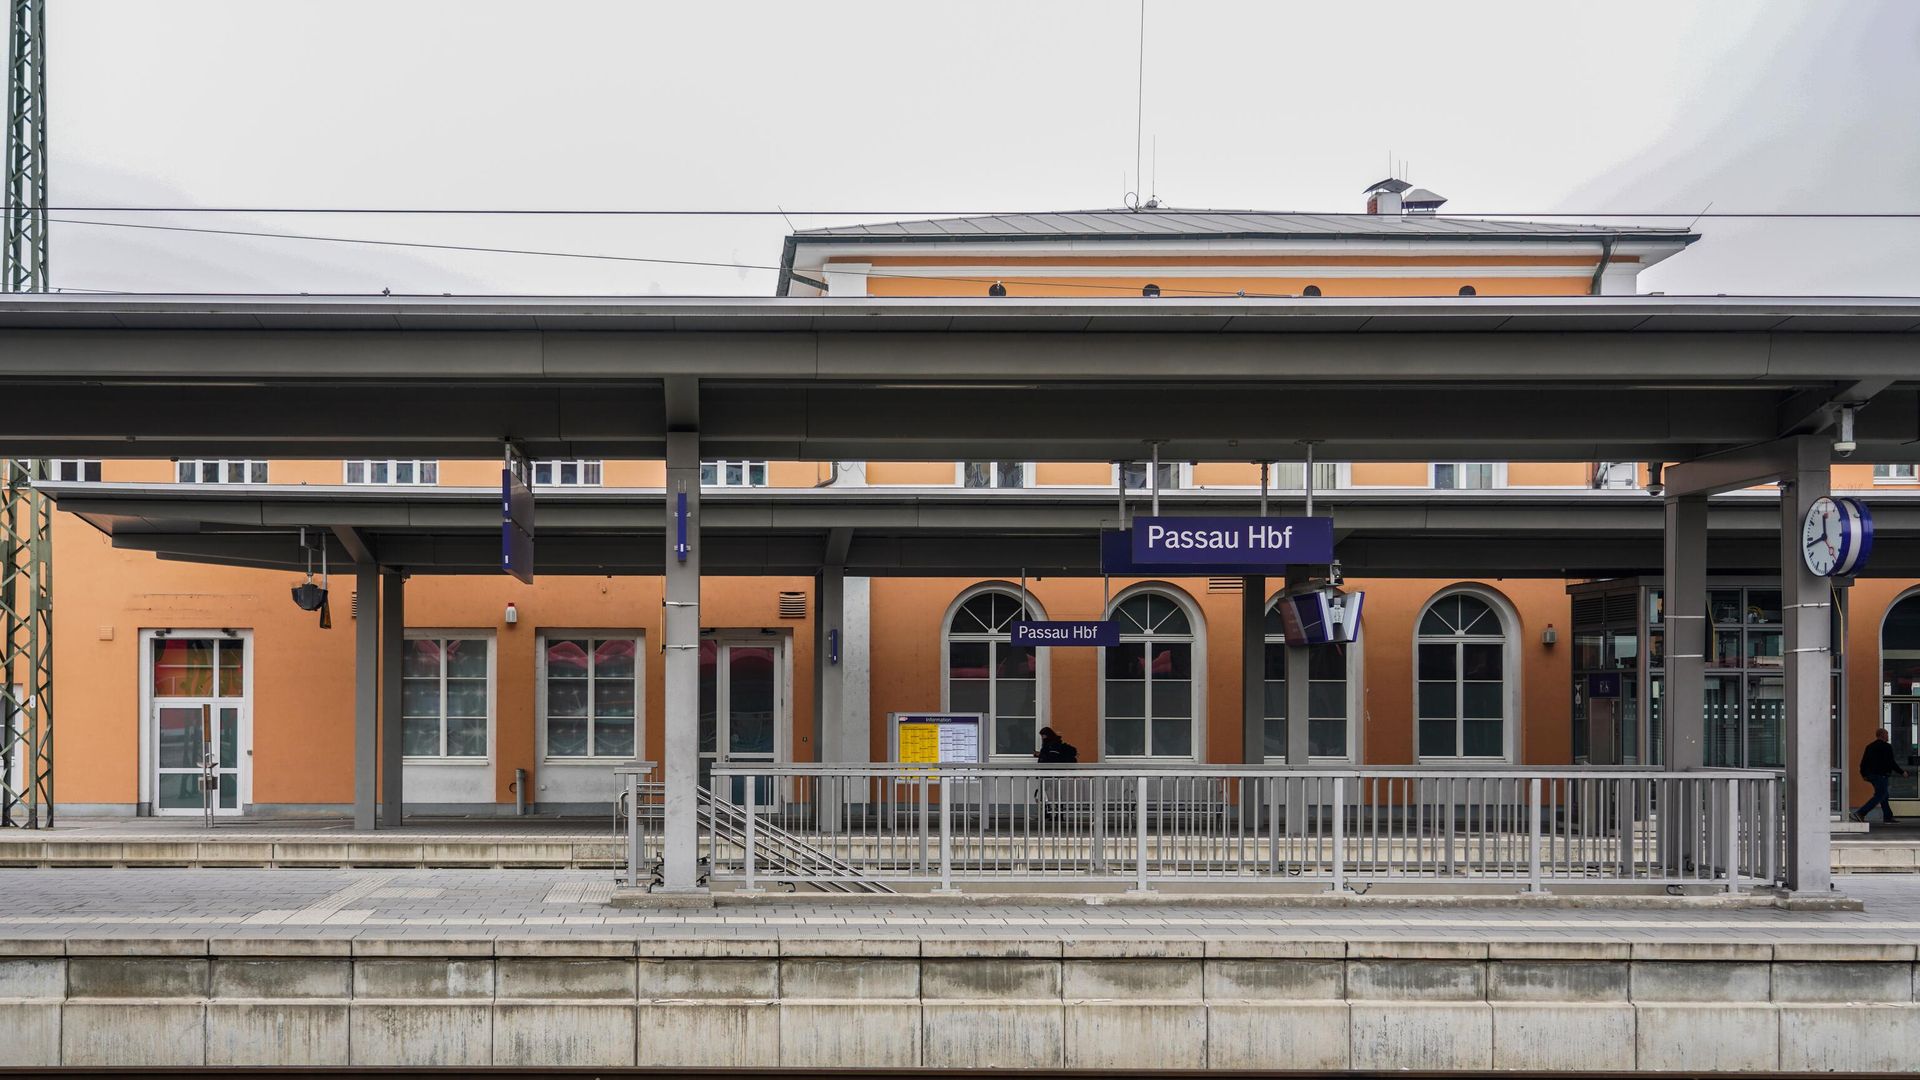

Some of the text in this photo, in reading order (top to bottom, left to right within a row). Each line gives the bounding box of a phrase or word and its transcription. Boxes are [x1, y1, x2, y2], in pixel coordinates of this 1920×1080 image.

[1148, 525, 1293, 549] Passau Hbf
[1019, 625, 1098, 639] Passau Hbf
